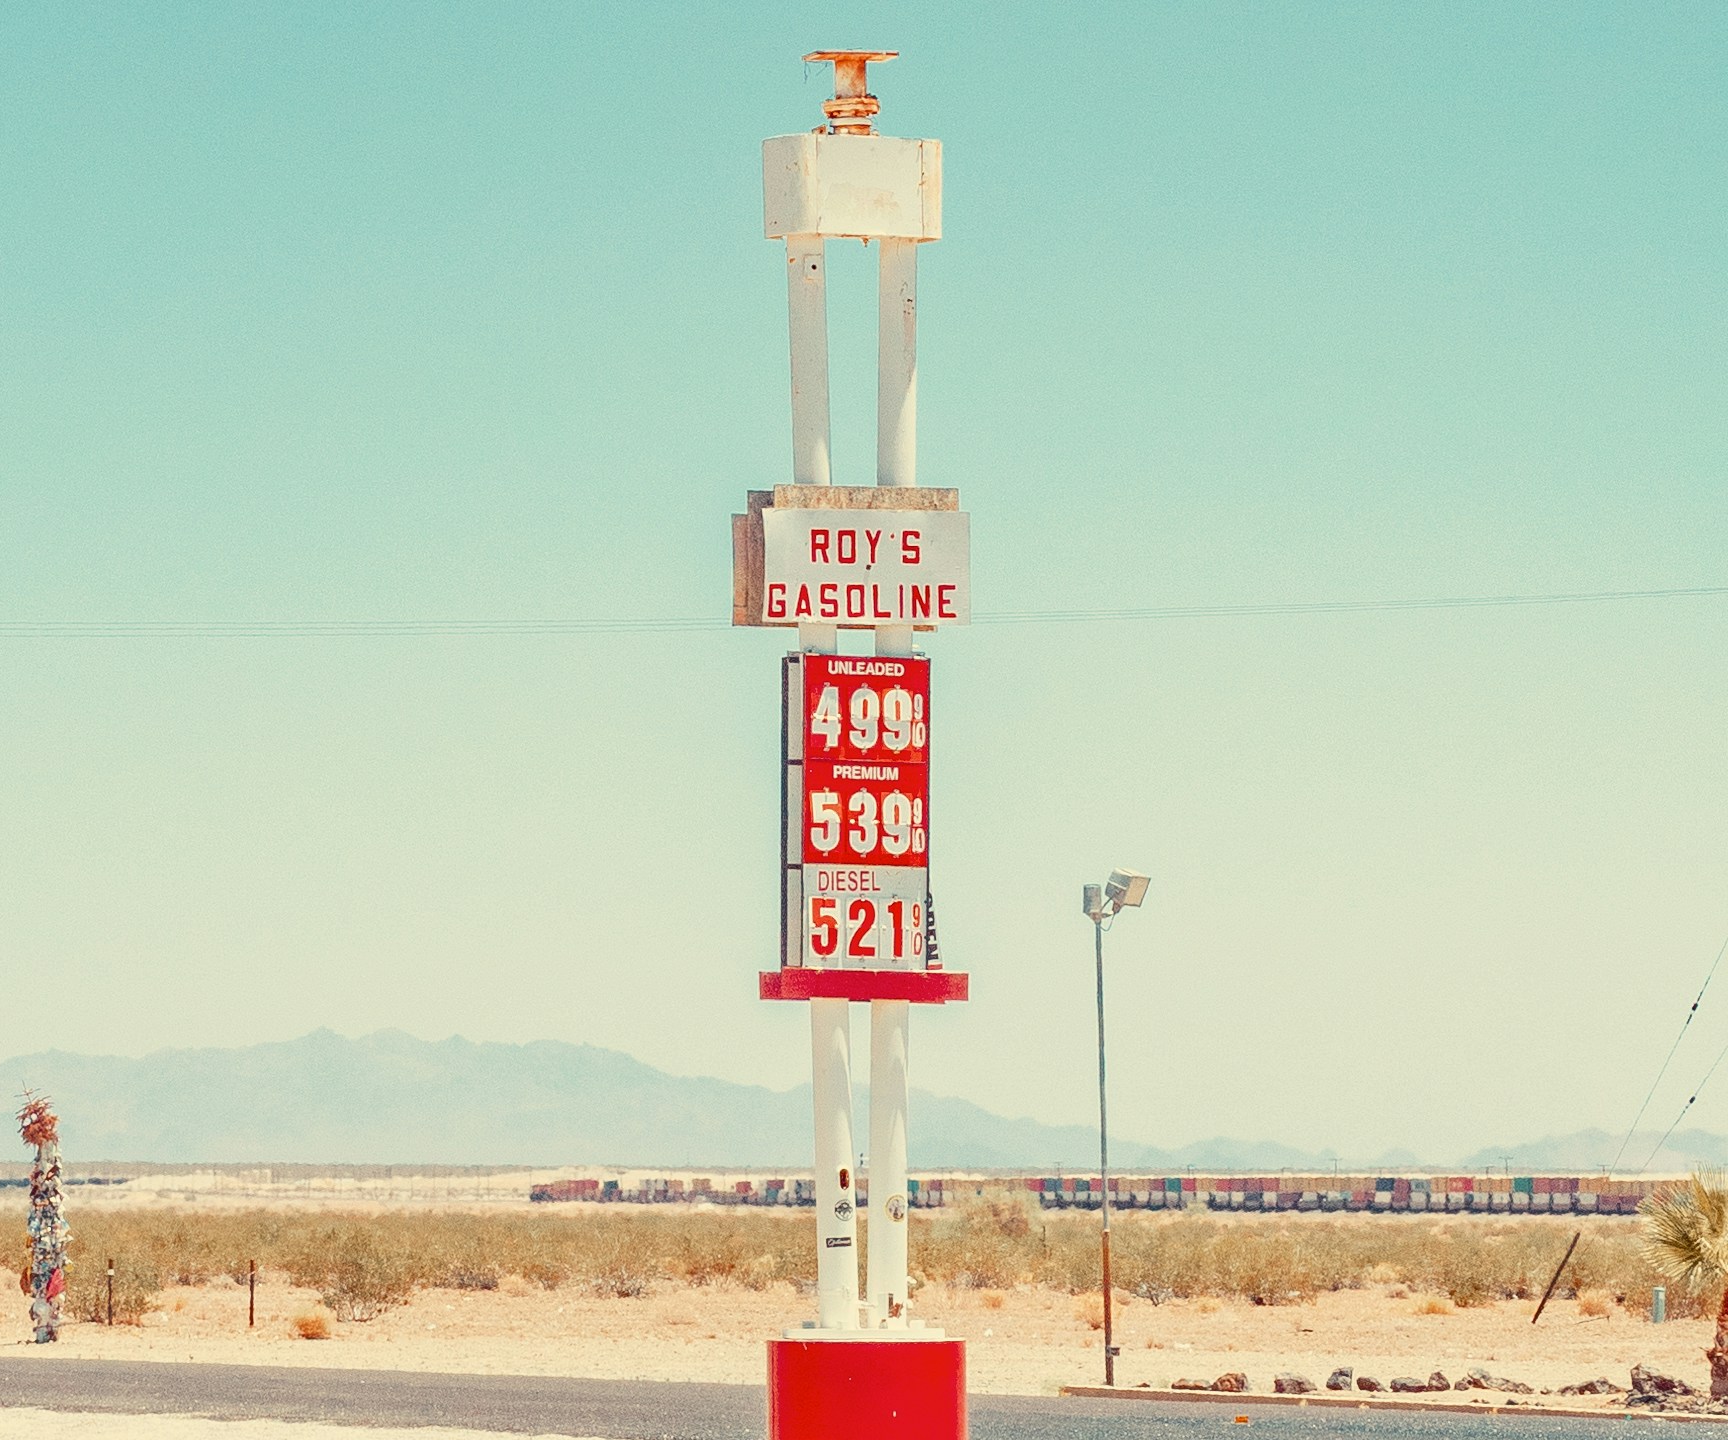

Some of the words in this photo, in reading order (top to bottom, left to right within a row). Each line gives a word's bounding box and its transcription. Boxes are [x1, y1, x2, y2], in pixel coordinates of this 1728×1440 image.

[810, 529, 921, 565] ROY'S
[767, 583, 958, 619] GASOLINE
[827, 660, 905, 677] UNLEADED
[832, 765, 900, 781] PREMIUM
[818, 870, 881, 892] DIESEL
